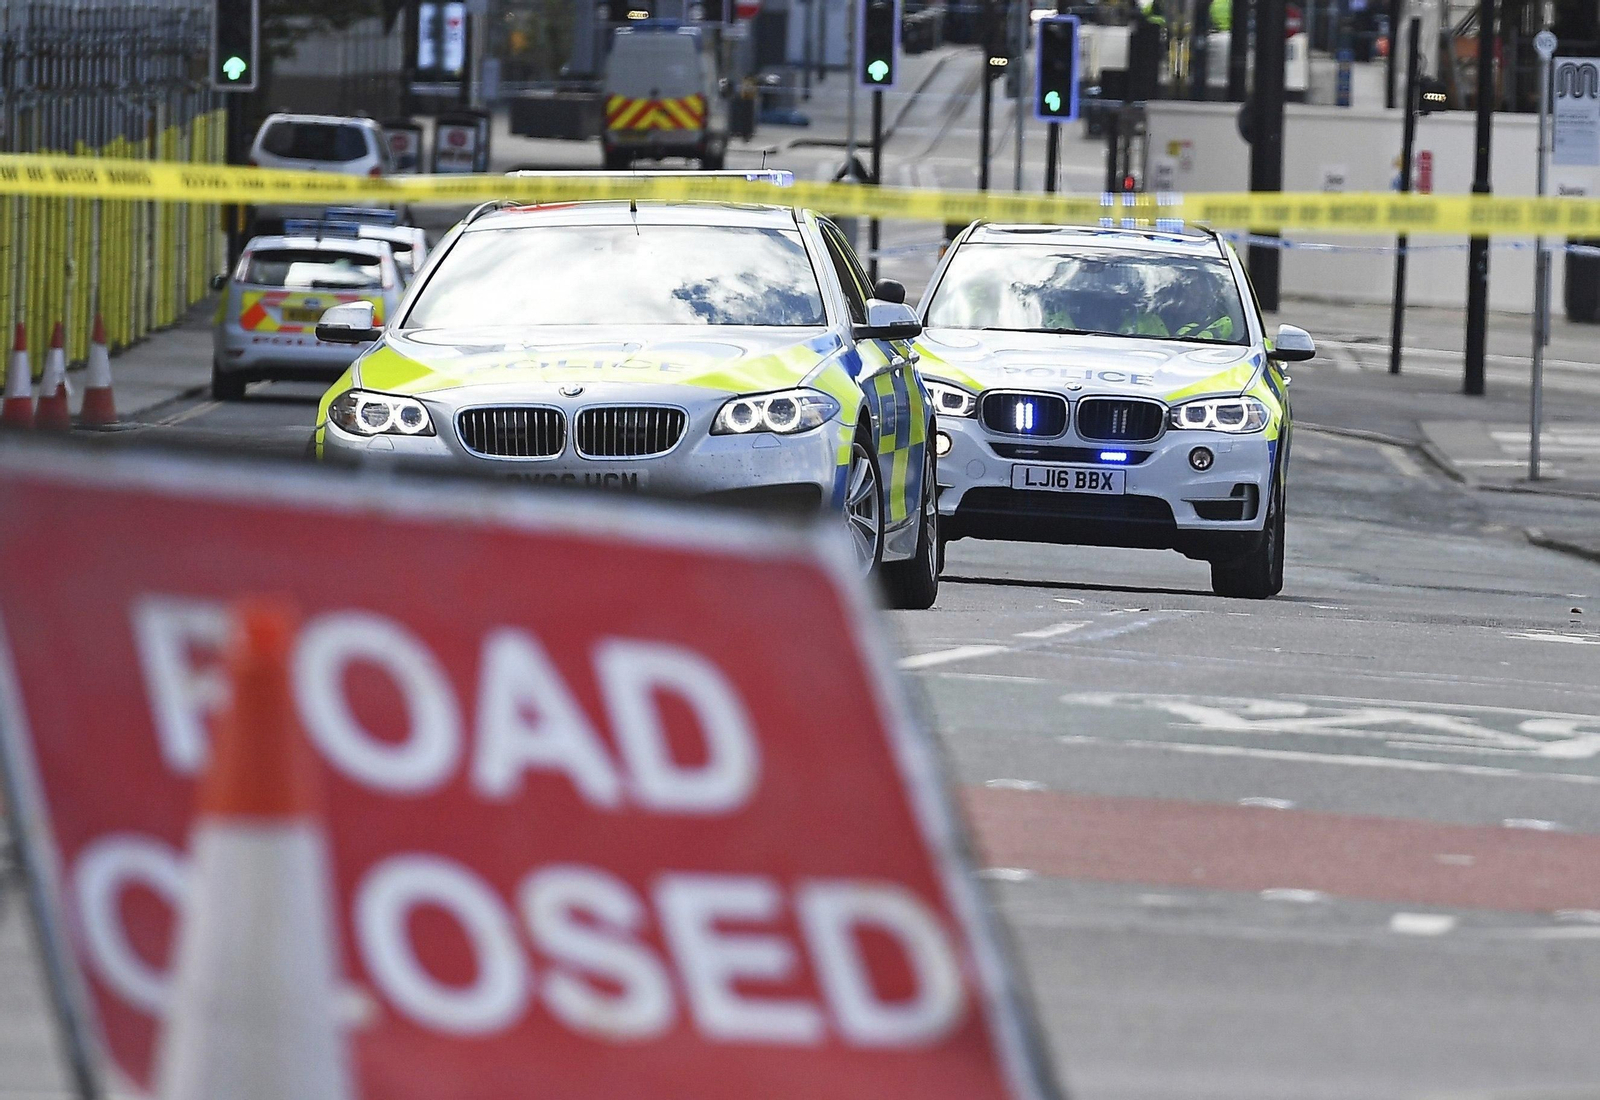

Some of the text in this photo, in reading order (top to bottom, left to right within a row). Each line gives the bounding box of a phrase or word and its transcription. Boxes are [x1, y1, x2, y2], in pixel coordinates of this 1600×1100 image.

[472, 358, 692, 374] POLICE
[998, 364, 1154, 386] POLICE
[1025, 468, 1113, 490] LJ16 BBX
[70, 832, 966, 1048] COSED
